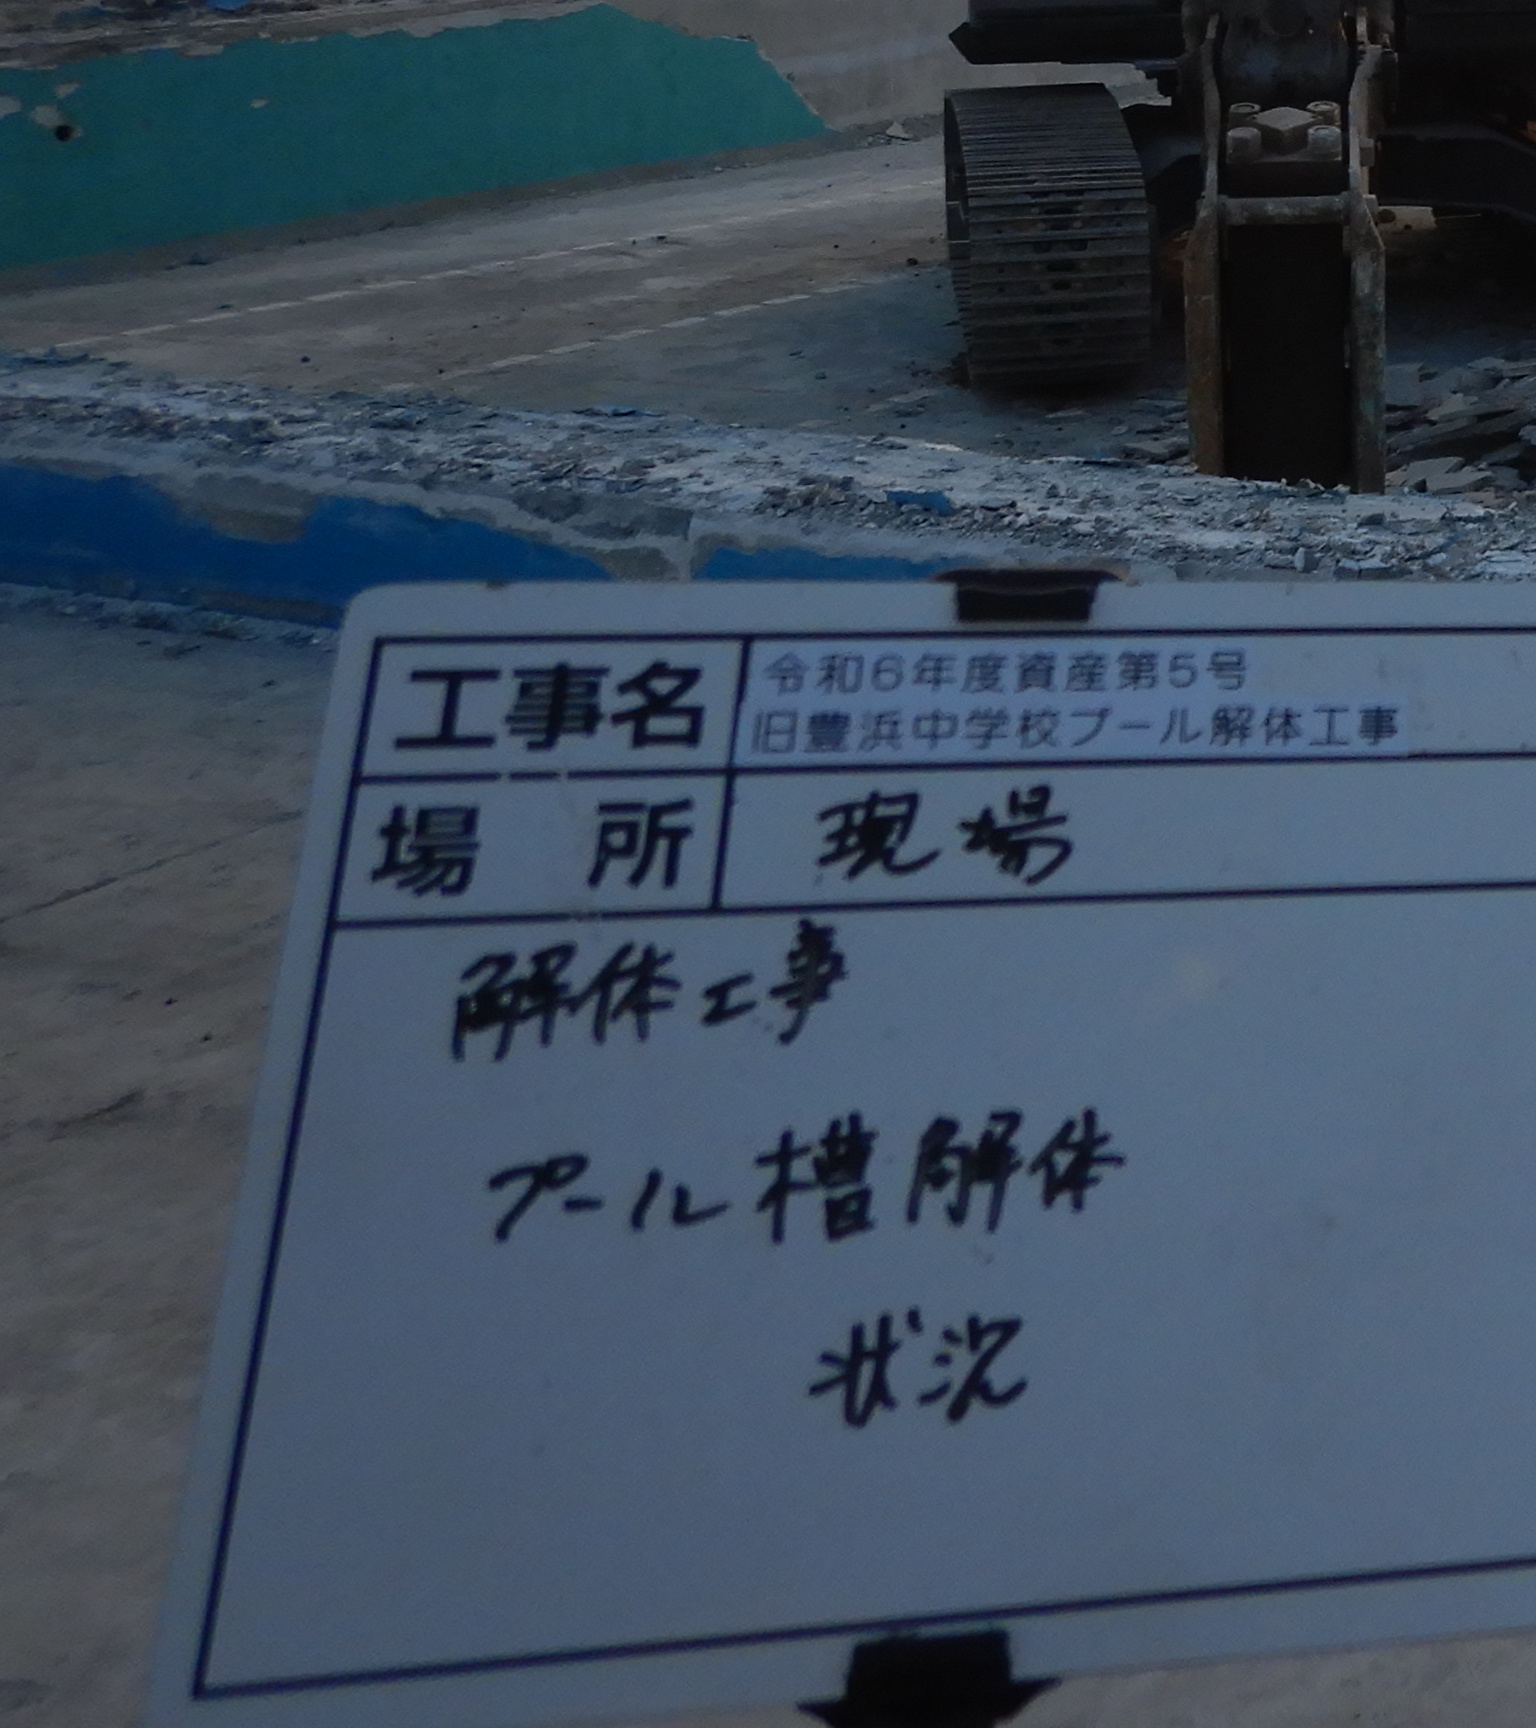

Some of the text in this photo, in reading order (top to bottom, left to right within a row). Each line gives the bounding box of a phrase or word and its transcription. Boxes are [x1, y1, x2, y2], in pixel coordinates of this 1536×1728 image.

[395, 662, 704, 751] 工事名
[764, 650, 1247, 693] 令和6年度資産第5号
[751, 706, 1399, 754] 旧豊浜中学校プール解体工事
[817, 785, 1073, 885] 現場
[451, 918, 849, 1060] 解体工事
[488, 1109, 1125, 1244] プール槽解体
[809, 1308, 1027, 1429] 状況
